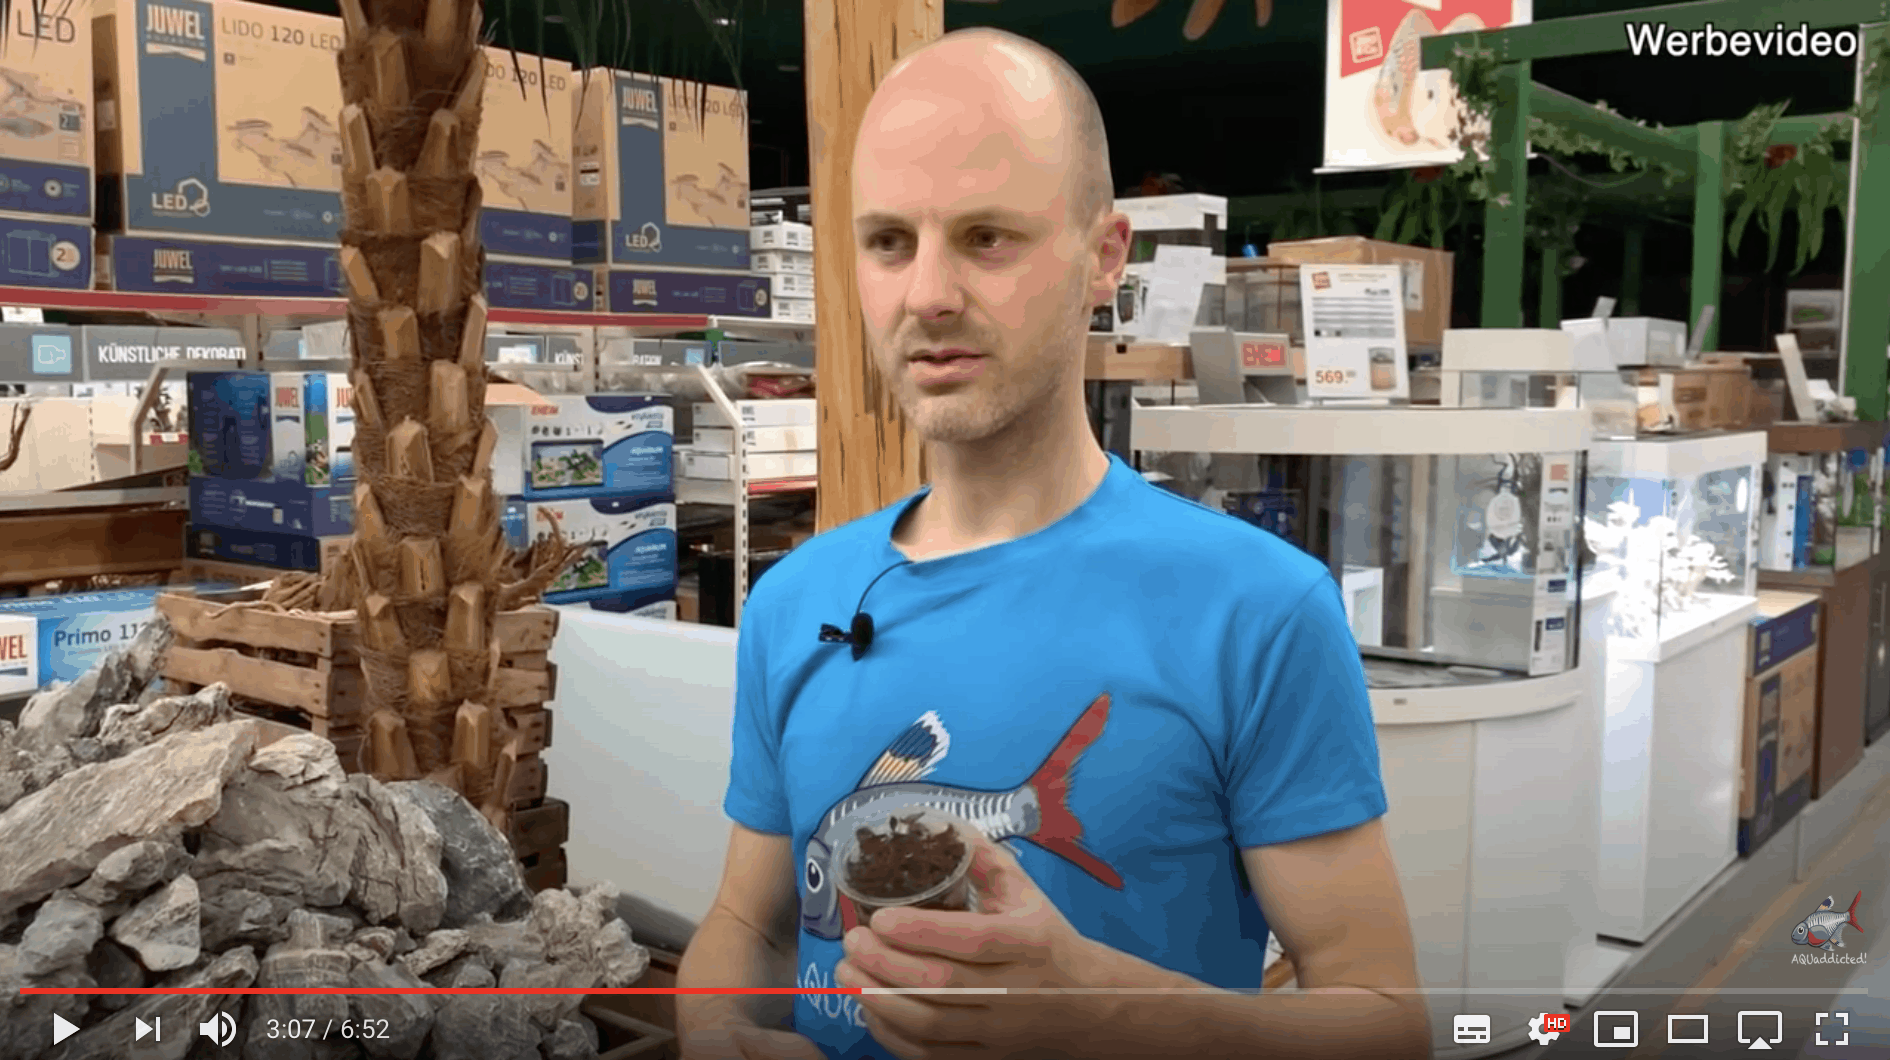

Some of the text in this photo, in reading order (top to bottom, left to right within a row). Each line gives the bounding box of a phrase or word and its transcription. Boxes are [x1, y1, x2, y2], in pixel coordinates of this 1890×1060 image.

[17, 9, 75, 43] LED
[146, 4, 206, 40] JUWEL
[221, 16, 341, 50] LIDO 120 LED
[622, 86, 658, 113] JUWEL
[152, 192, 187, 210] LED
[625, 233, 649, 248] LED
[153, 249, 194, 269] JUWEL
[98, 343, 182, 363] KÜNSTLICHE
[53, 629, 111, 647] Primo
